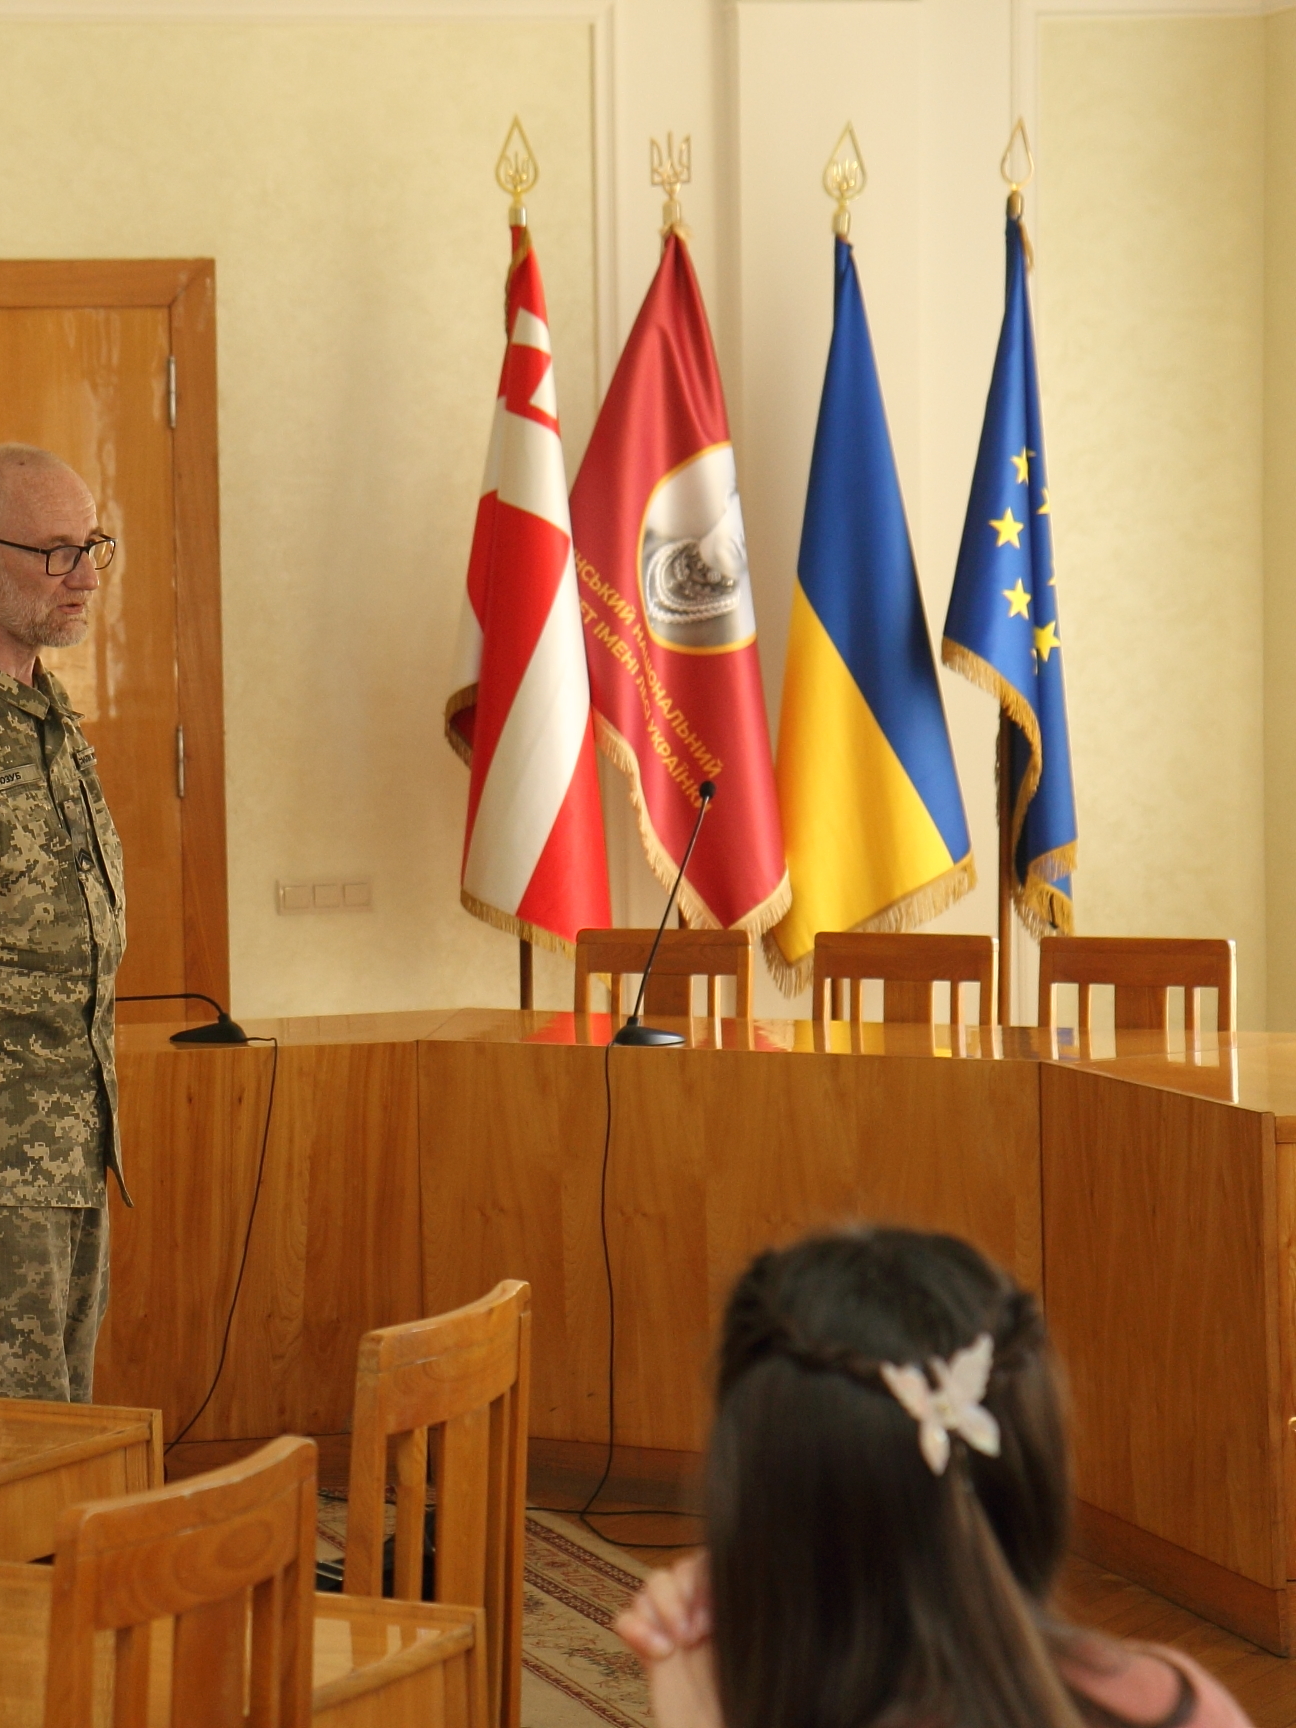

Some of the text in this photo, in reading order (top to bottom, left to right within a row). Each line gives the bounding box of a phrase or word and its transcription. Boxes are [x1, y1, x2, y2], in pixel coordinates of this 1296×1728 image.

[575, 549, 724, 778] НСЬКИЙ НАЦІОНАЛЬНИЙ
[593, 621, 639, 676] ІМЕНІ
